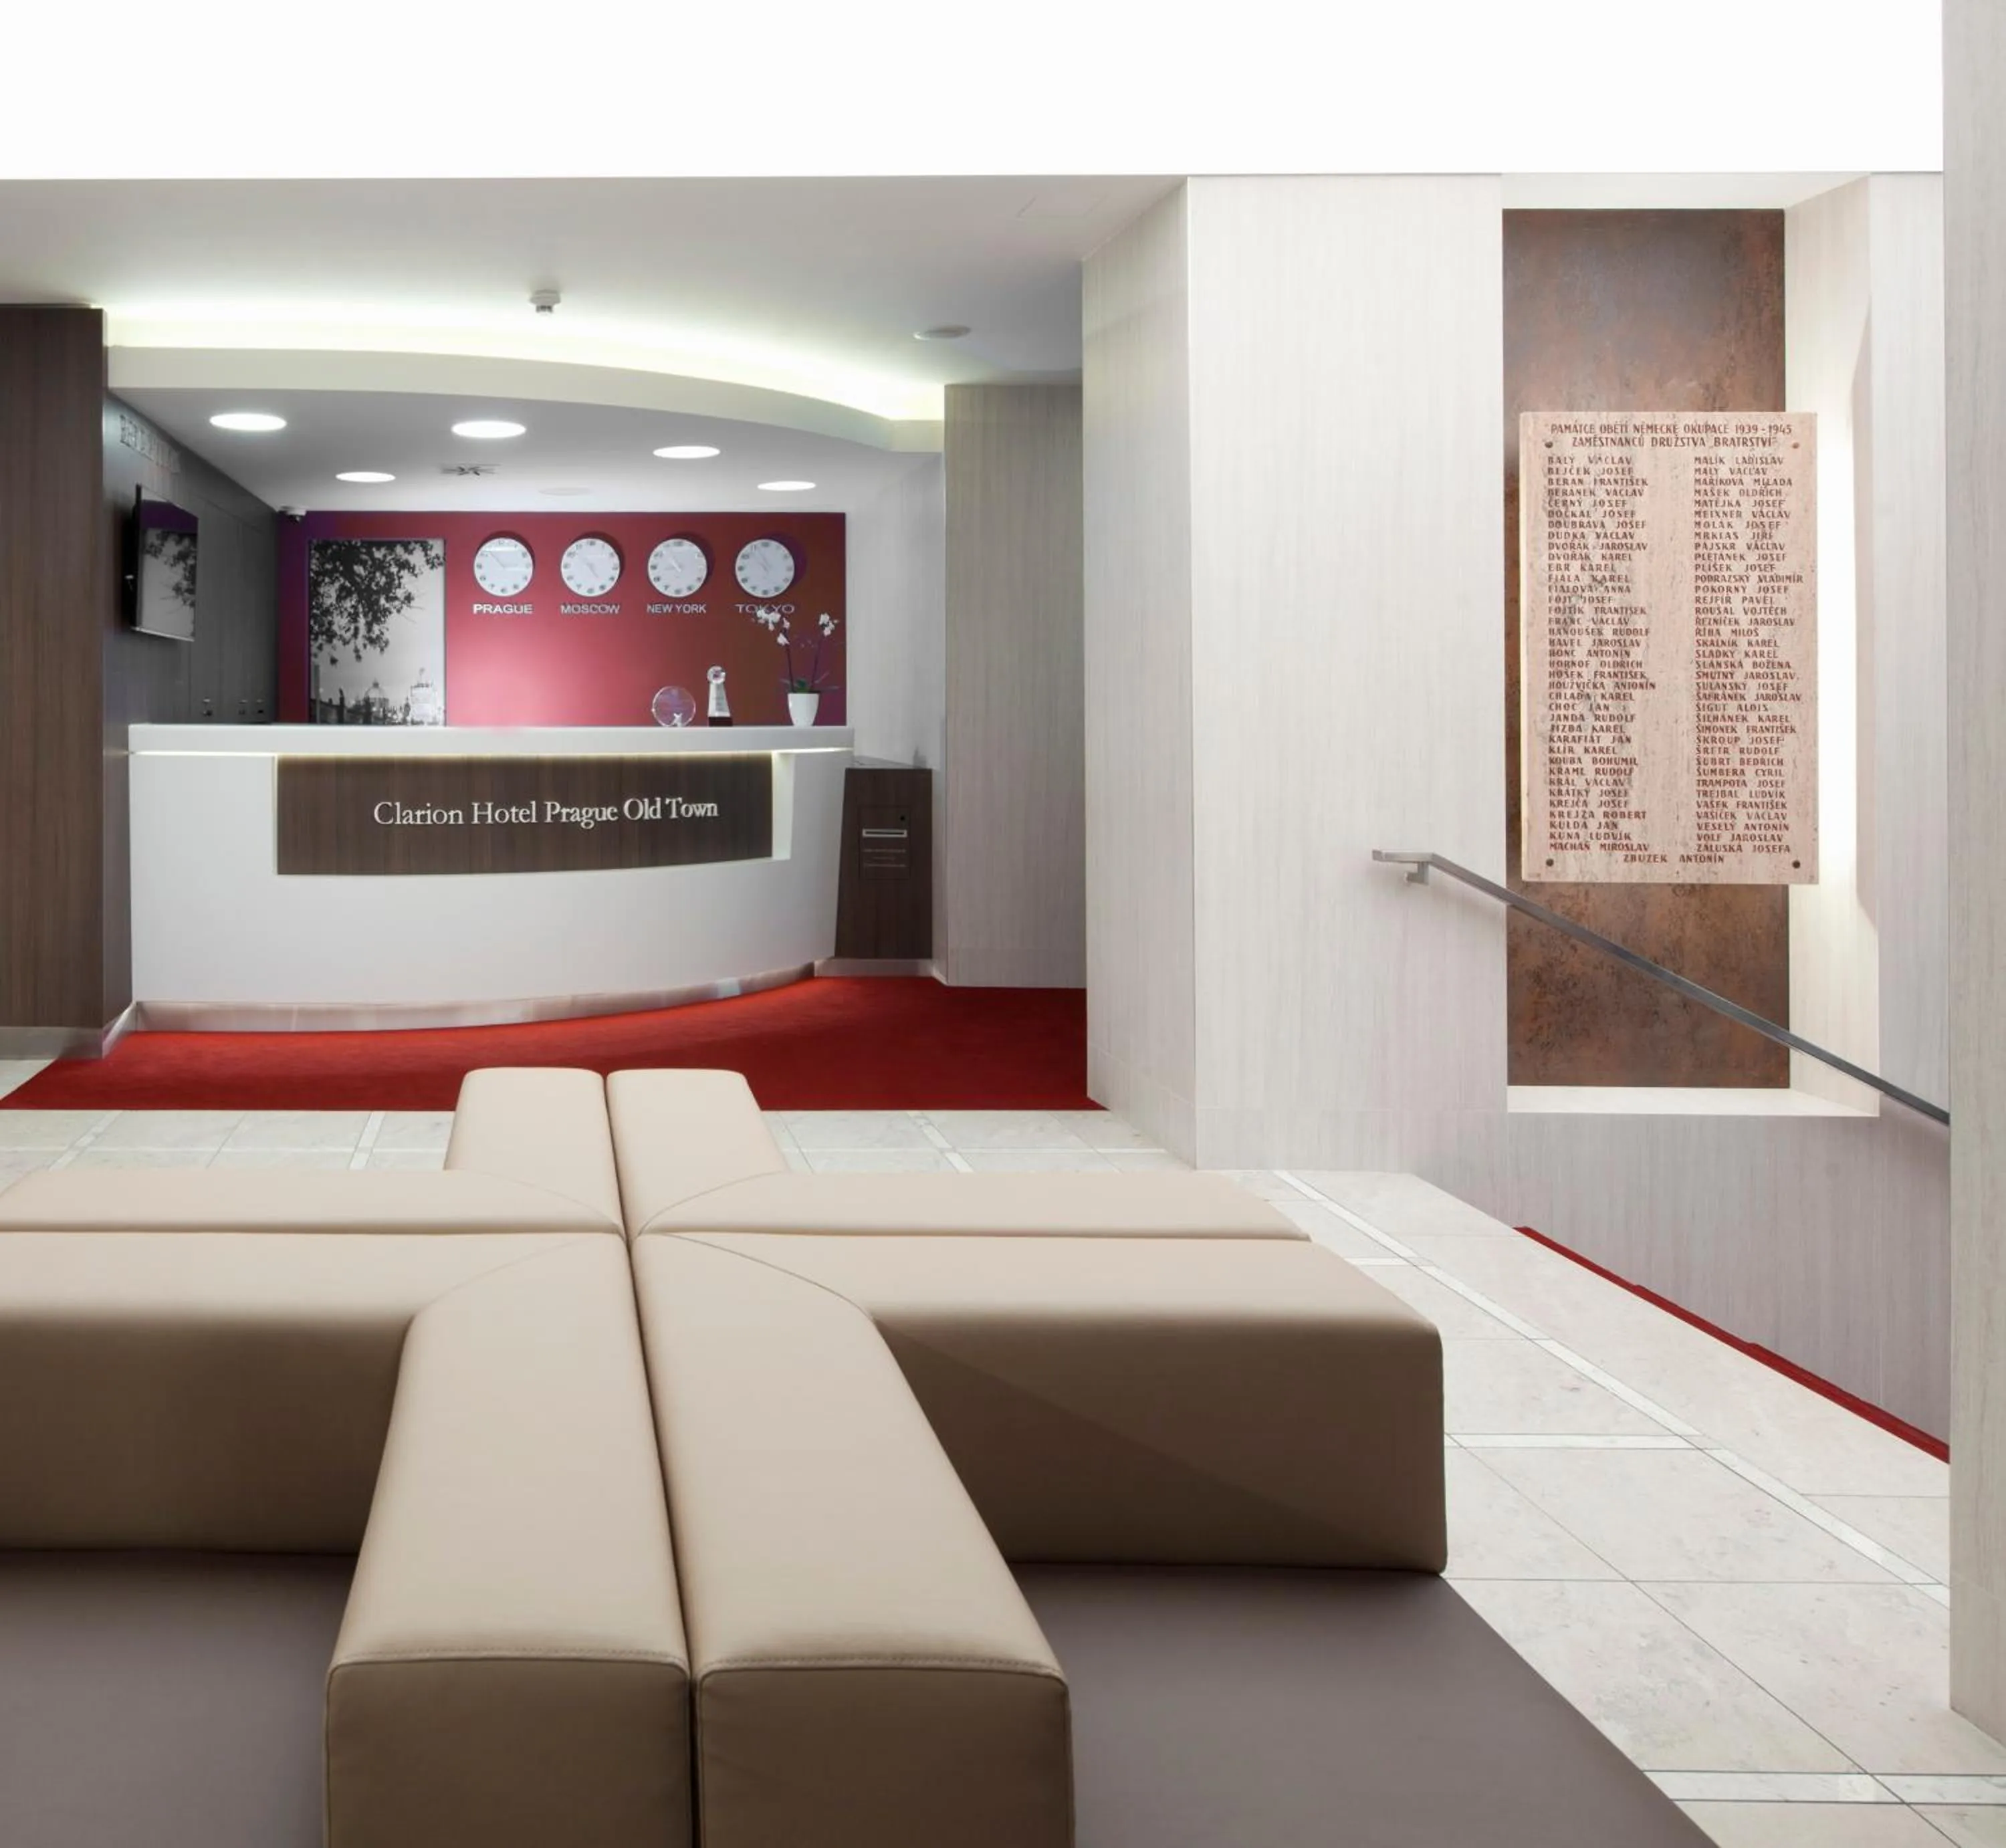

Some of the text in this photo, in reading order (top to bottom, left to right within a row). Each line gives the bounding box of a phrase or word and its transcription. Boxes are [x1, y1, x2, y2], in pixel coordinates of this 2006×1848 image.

[473, 604, 533, 614] PRAGUE
[560, 604, 620, 614] MOSCOW
[647, 604, 707, 613] NEW YORK
[374, 796, 719, 828] Clarion Hotel Prague Old Town
